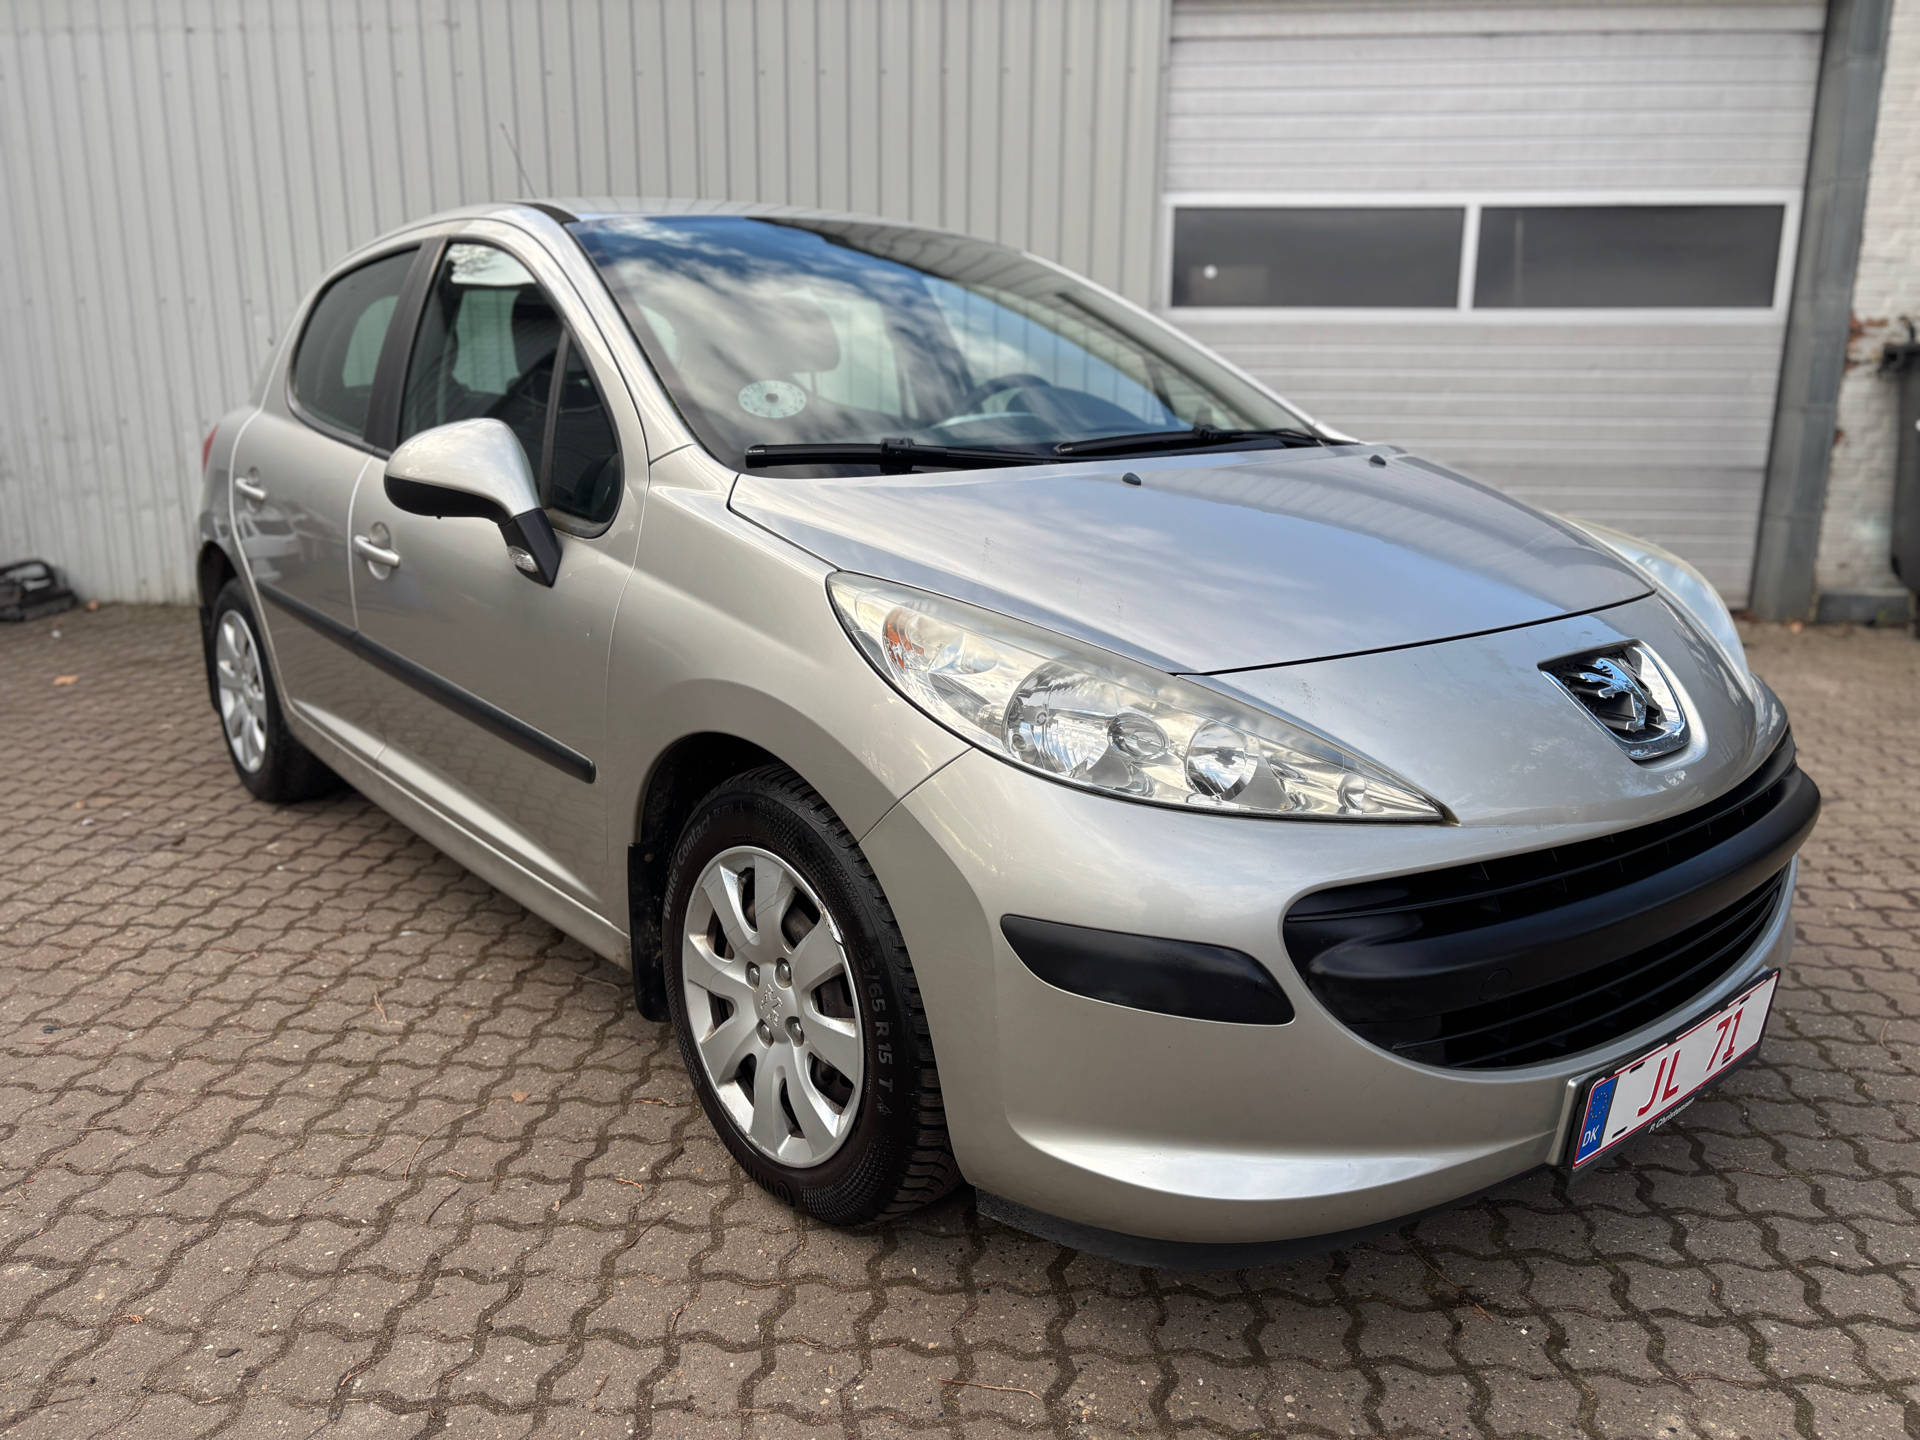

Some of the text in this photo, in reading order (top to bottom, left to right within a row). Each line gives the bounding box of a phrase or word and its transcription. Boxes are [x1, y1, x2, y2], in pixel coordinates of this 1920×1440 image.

[677, 813, 711, 866] Contact
[875, 1021, 890, 1037] R
[878, 1042, 893, 1065] 15
[1636, 1006, 1745, 1118] JL 71
[1581, 1125, 1600, 1148] DK
